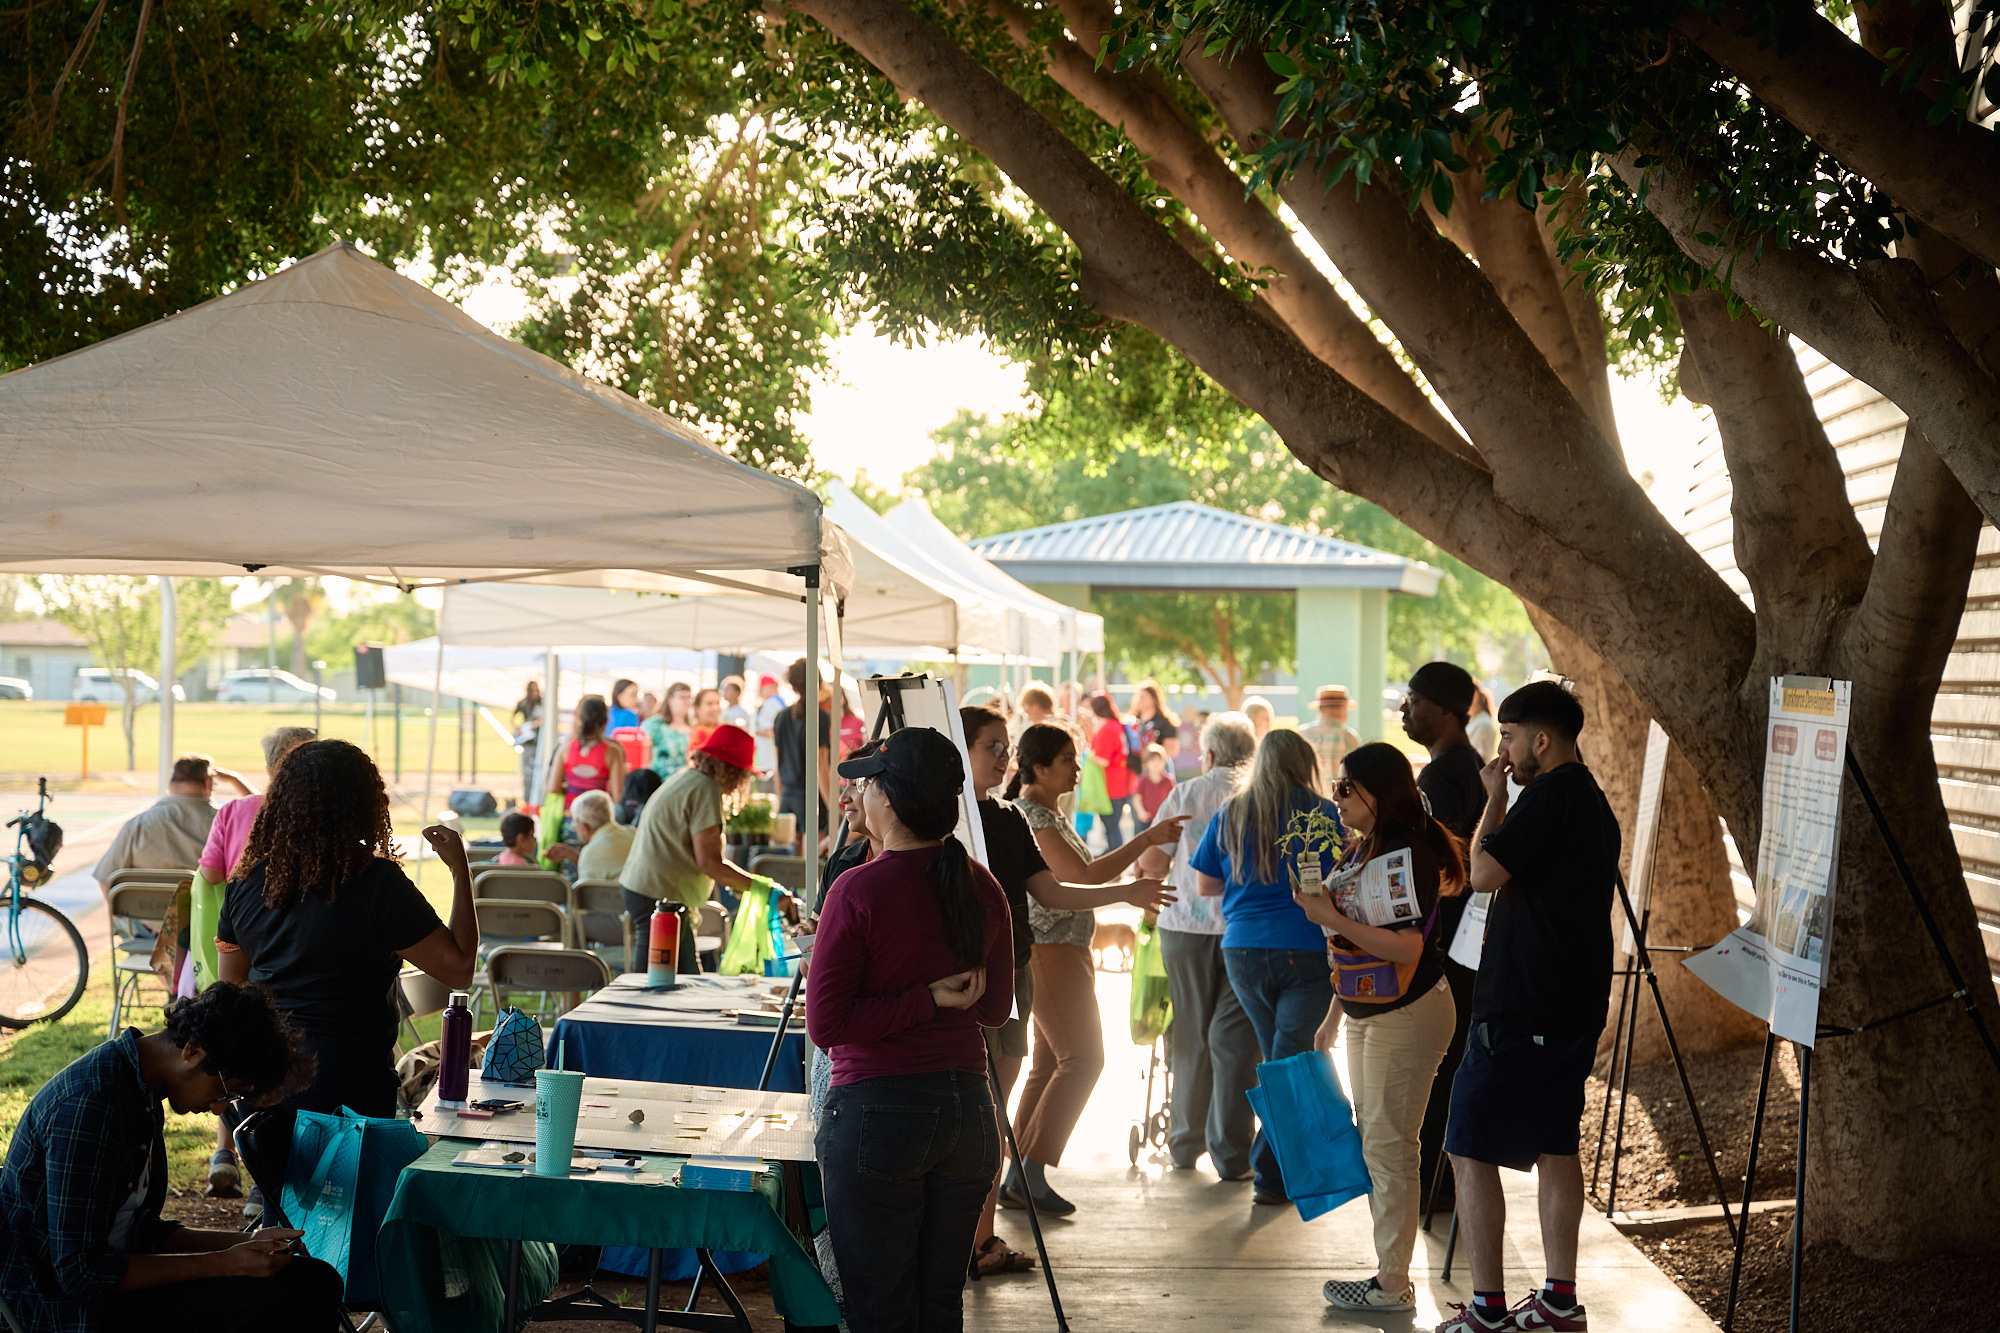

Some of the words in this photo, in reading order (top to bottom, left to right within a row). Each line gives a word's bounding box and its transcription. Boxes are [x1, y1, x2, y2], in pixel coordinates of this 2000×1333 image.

[1784, 688, 1805, 708] Workforce
[1805, 690, 1835, 714] Development
[1741, 945, 1757, 957] Would
